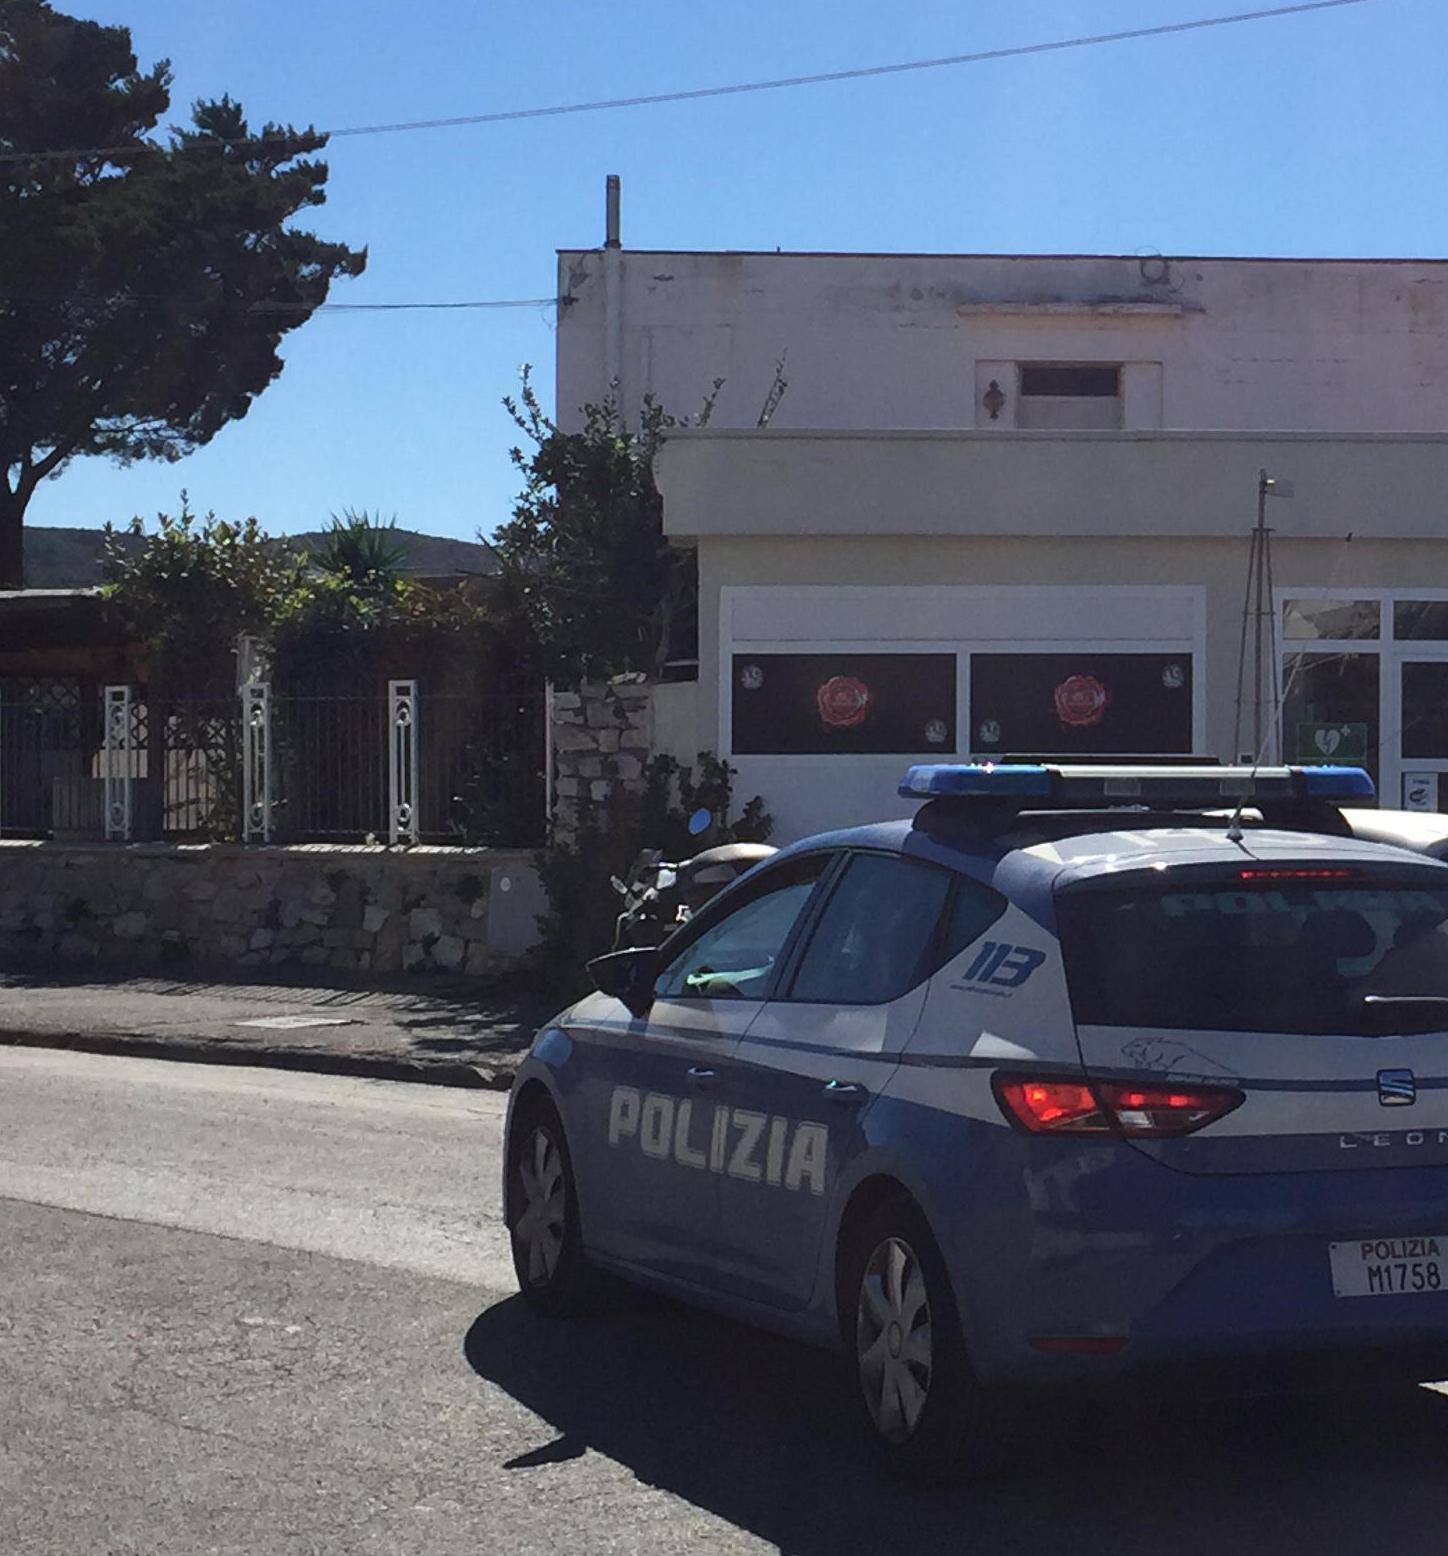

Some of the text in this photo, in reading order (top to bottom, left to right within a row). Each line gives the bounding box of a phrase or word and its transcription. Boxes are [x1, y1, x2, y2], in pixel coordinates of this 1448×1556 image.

[962, 941, 1046, 988] 113
[607, 1085, 829, 1196] POLIZIA
[1361, 1239, 1440, 1260] POLIZIA
[1368, 1262, 1441, 1292] M1758
